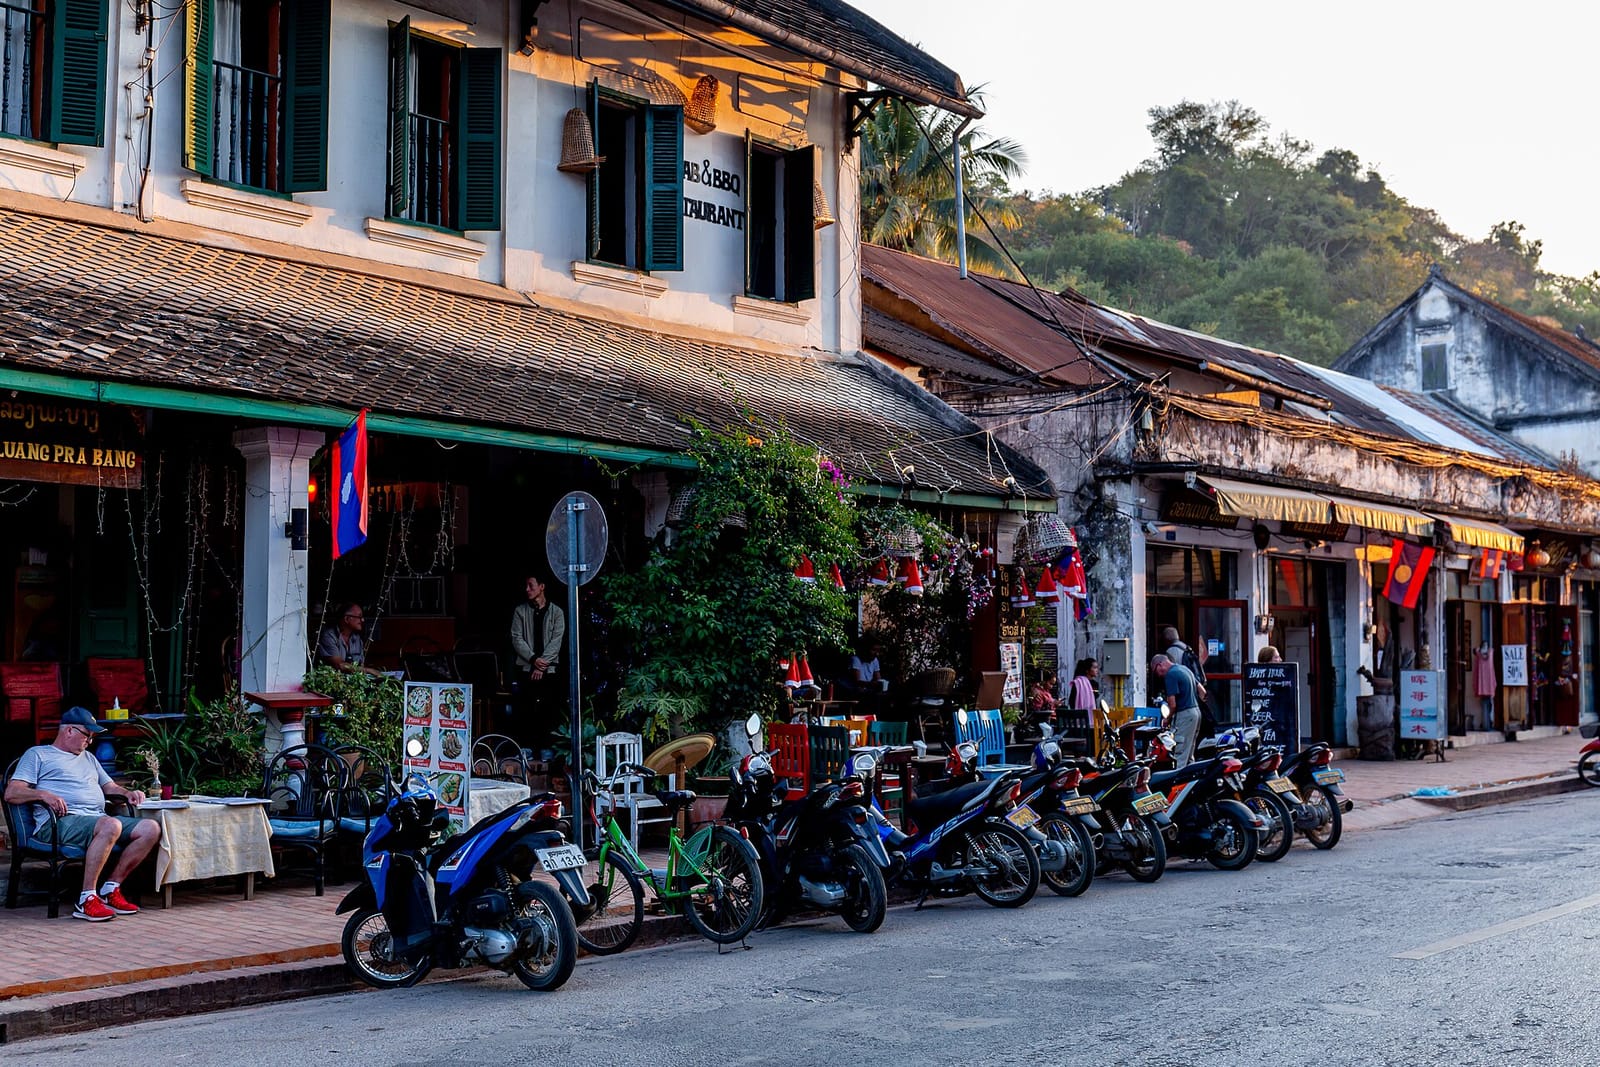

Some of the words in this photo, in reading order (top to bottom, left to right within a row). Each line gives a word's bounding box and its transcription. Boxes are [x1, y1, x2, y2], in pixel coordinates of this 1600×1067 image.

[713, 168, 740, 197] BBQ
[92, 448, 136, 469] BANG
[1504, 648, 1524, 660] SALE
[1263, 728, 1275, 741] TEA
[561, 854, 585, 867] 1315
